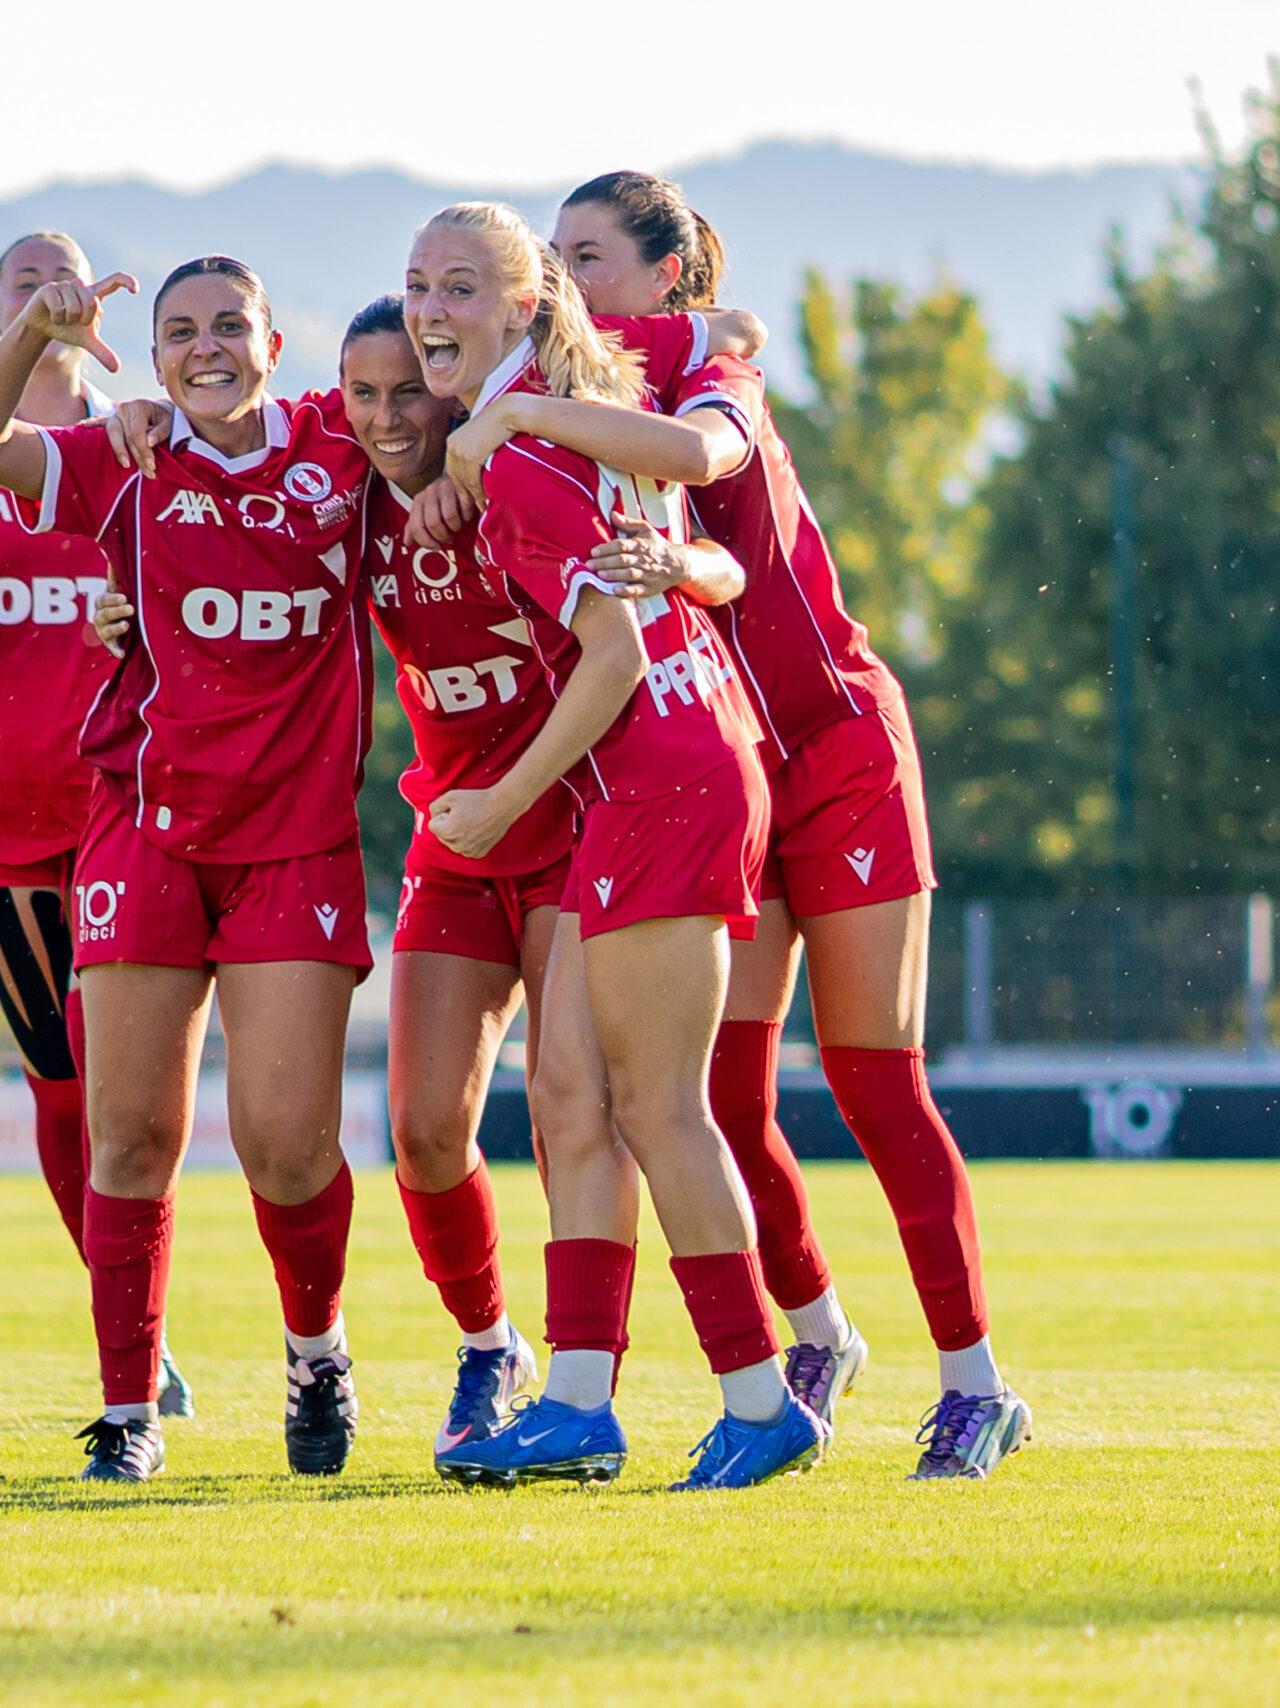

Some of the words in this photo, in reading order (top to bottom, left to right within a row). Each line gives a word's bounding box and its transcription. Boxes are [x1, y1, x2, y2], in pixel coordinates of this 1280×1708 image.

[156, 489, 224, 527] AXA
[370, 574, 401, 608] XA
[182, 586, 332, 641] OBT
